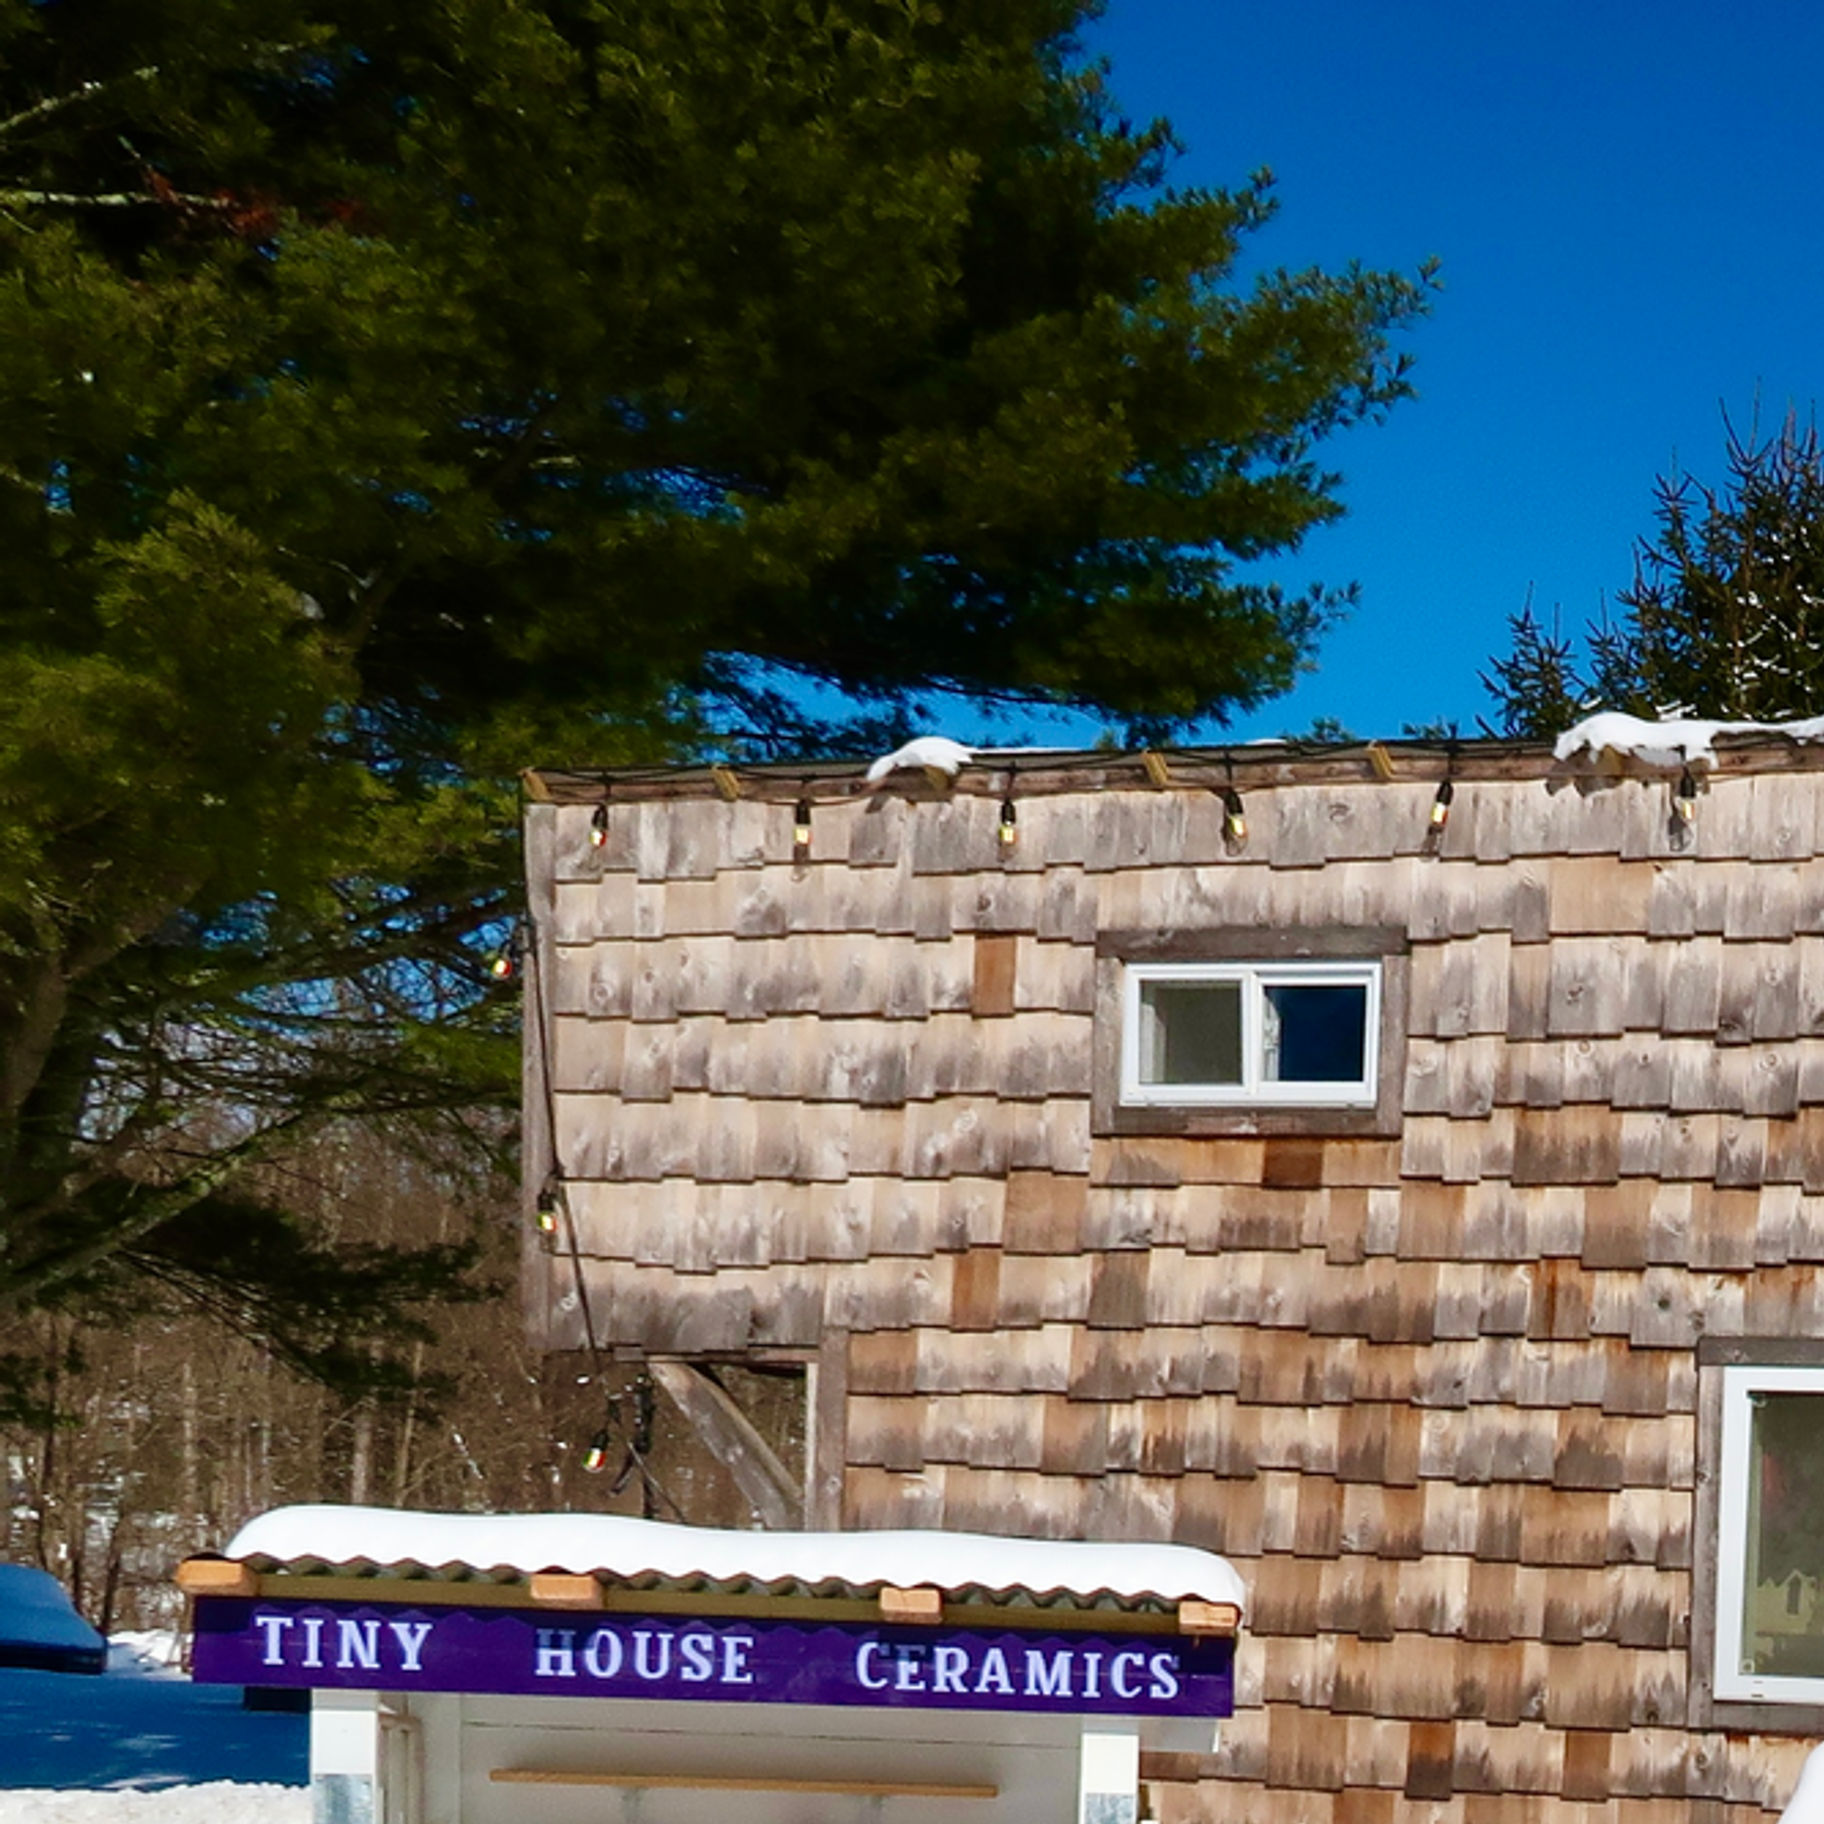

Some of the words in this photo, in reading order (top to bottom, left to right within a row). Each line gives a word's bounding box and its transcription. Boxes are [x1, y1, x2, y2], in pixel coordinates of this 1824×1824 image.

[255, 1616, 433, 1671] TINY
[534, 1628, 754, 1684] HOUSE
[855, 1641, 1181, 1699] CERAMICS
